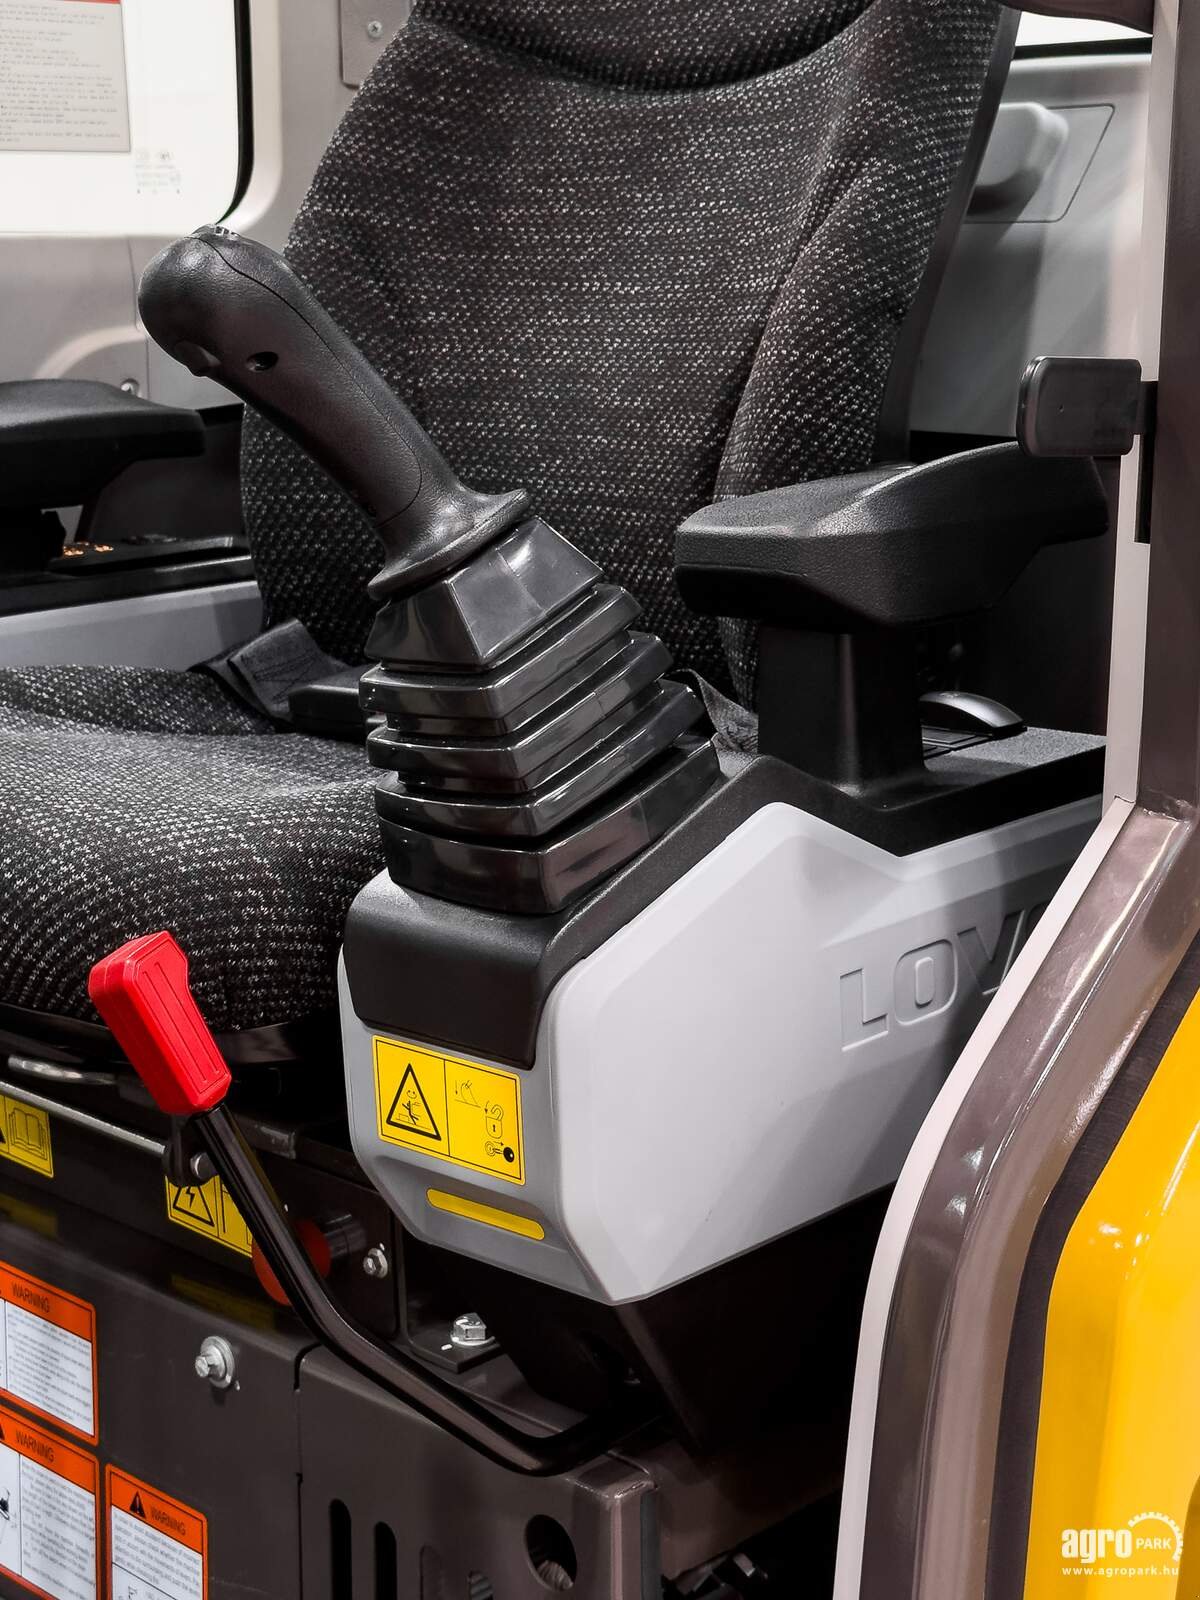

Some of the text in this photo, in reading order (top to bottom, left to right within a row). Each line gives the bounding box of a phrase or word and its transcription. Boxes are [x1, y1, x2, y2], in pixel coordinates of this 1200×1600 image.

[840, 904, 1048, 1052] LOV
[12, 1282, 50, 1313] WARNING
[16, 1430, 55, 1463] WARNING
[150, 1507, 186, 1536] WARNING
